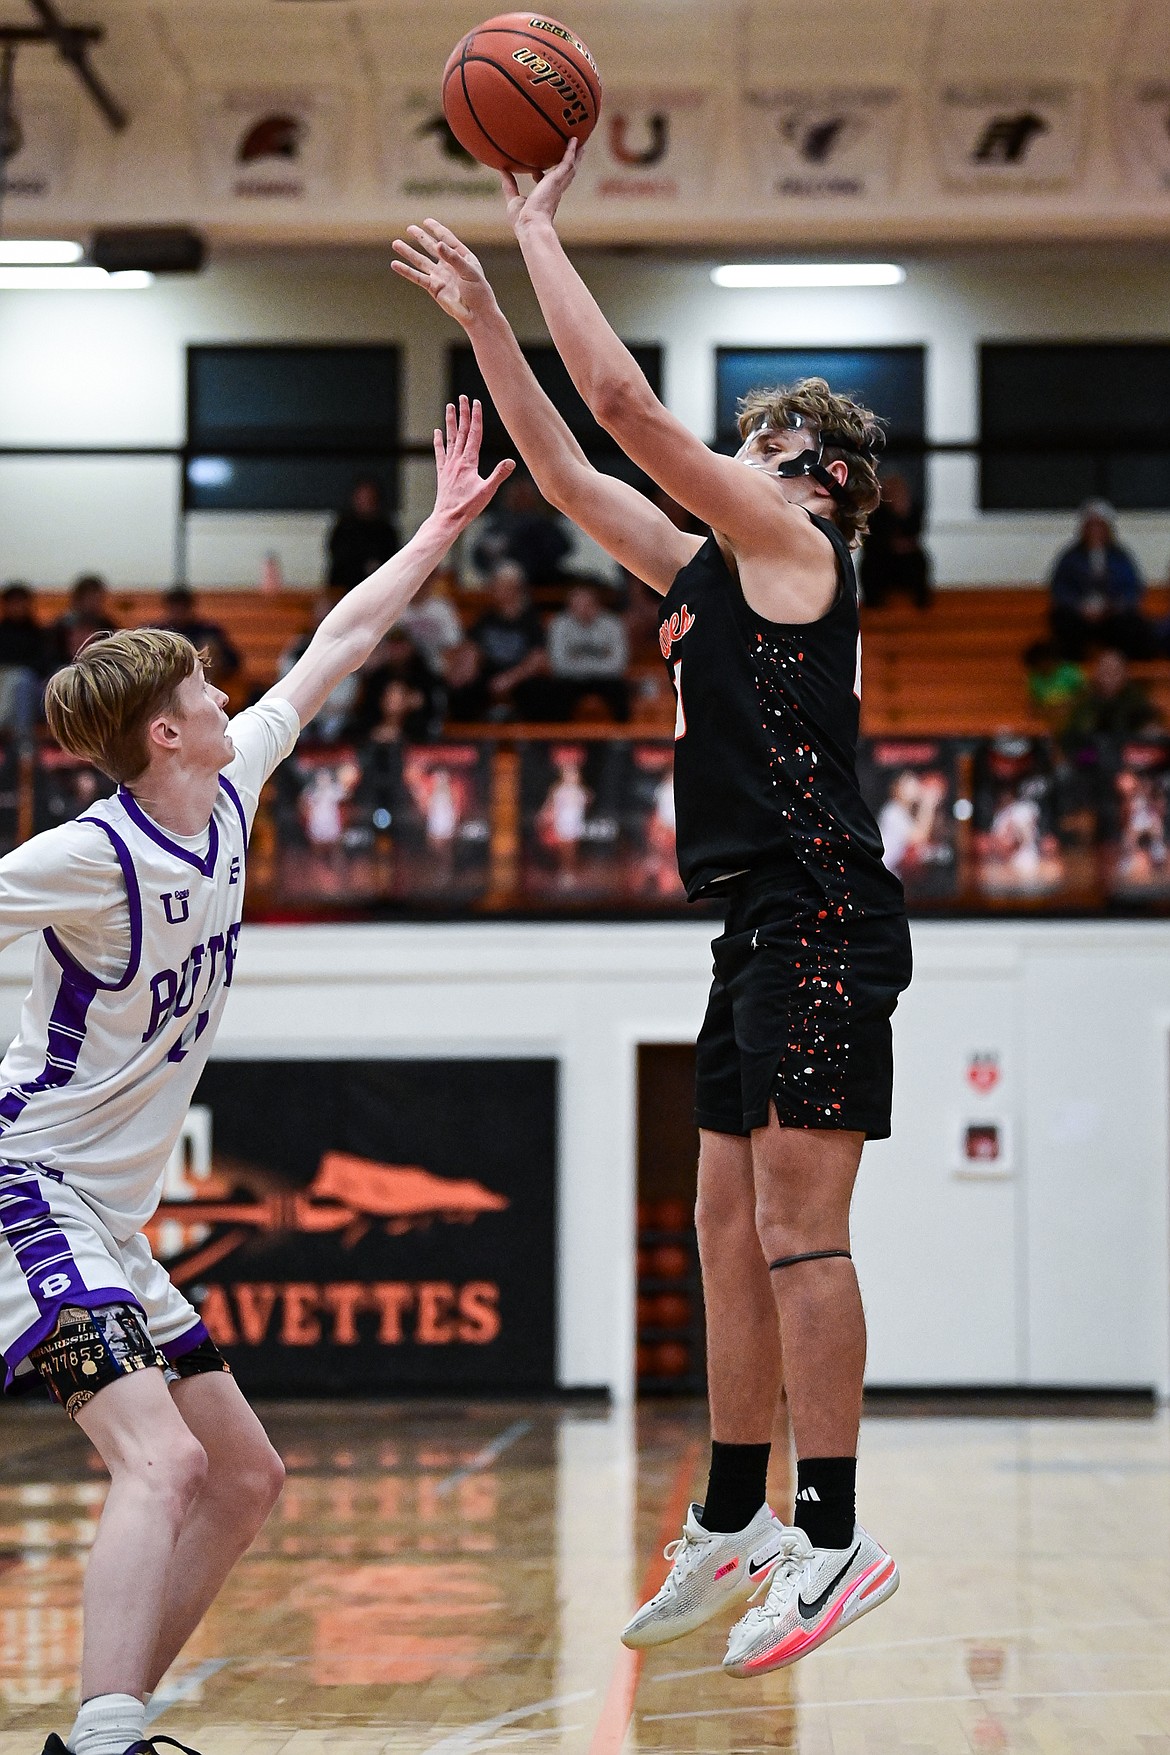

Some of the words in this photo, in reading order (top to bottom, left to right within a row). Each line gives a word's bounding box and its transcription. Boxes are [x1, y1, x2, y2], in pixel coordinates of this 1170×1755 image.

[512, 47, 589, 127] Baden
[38, 1273, 72, 1299] B
[202, 1281, 501, 1347] AVETTES
[53, 1331, 100, 1350] RESER
